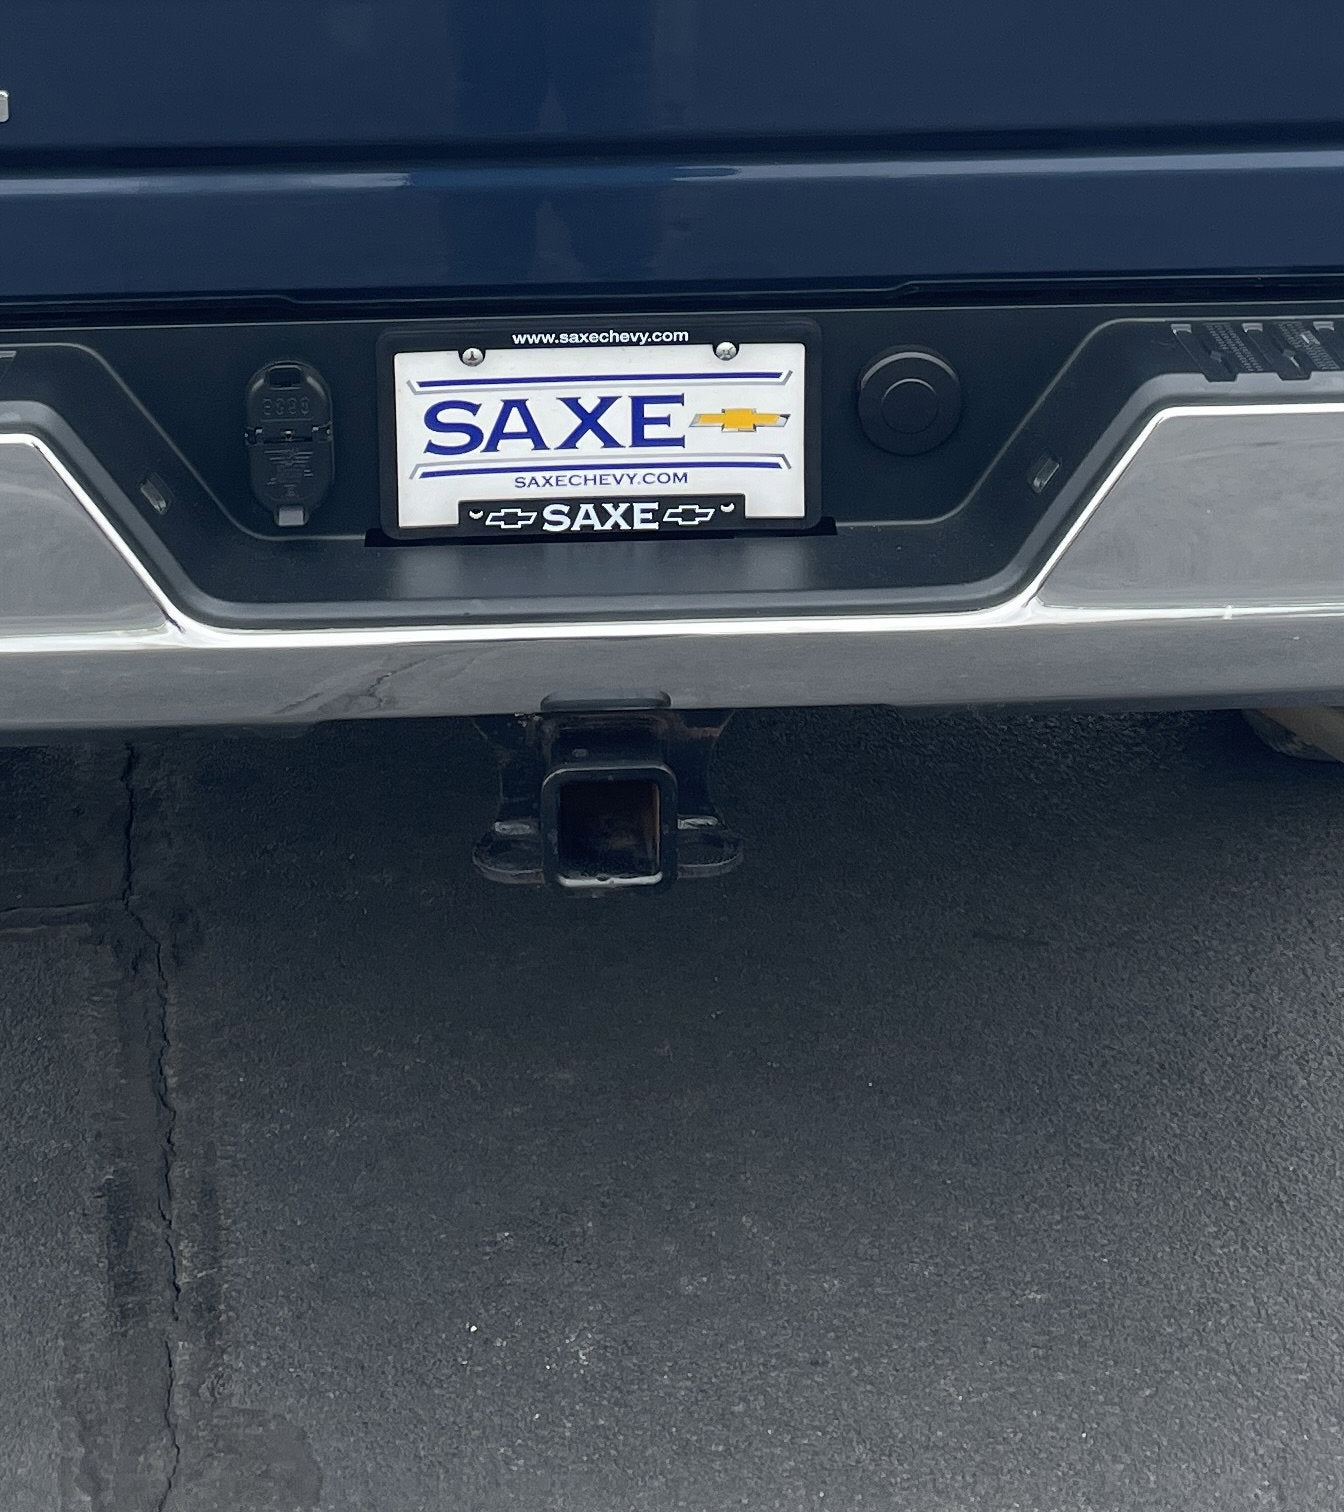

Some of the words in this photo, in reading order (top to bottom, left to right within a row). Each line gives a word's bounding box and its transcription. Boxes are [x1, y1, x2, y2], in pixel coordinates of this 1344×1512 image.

[512, 329, 689, 346] www.saxechevy.com
[423, 392, 687, 456] SAXE
[514, 471, 688, 489] SAXECHEVY.COM
[542, 501, 660, 532] SAXE
